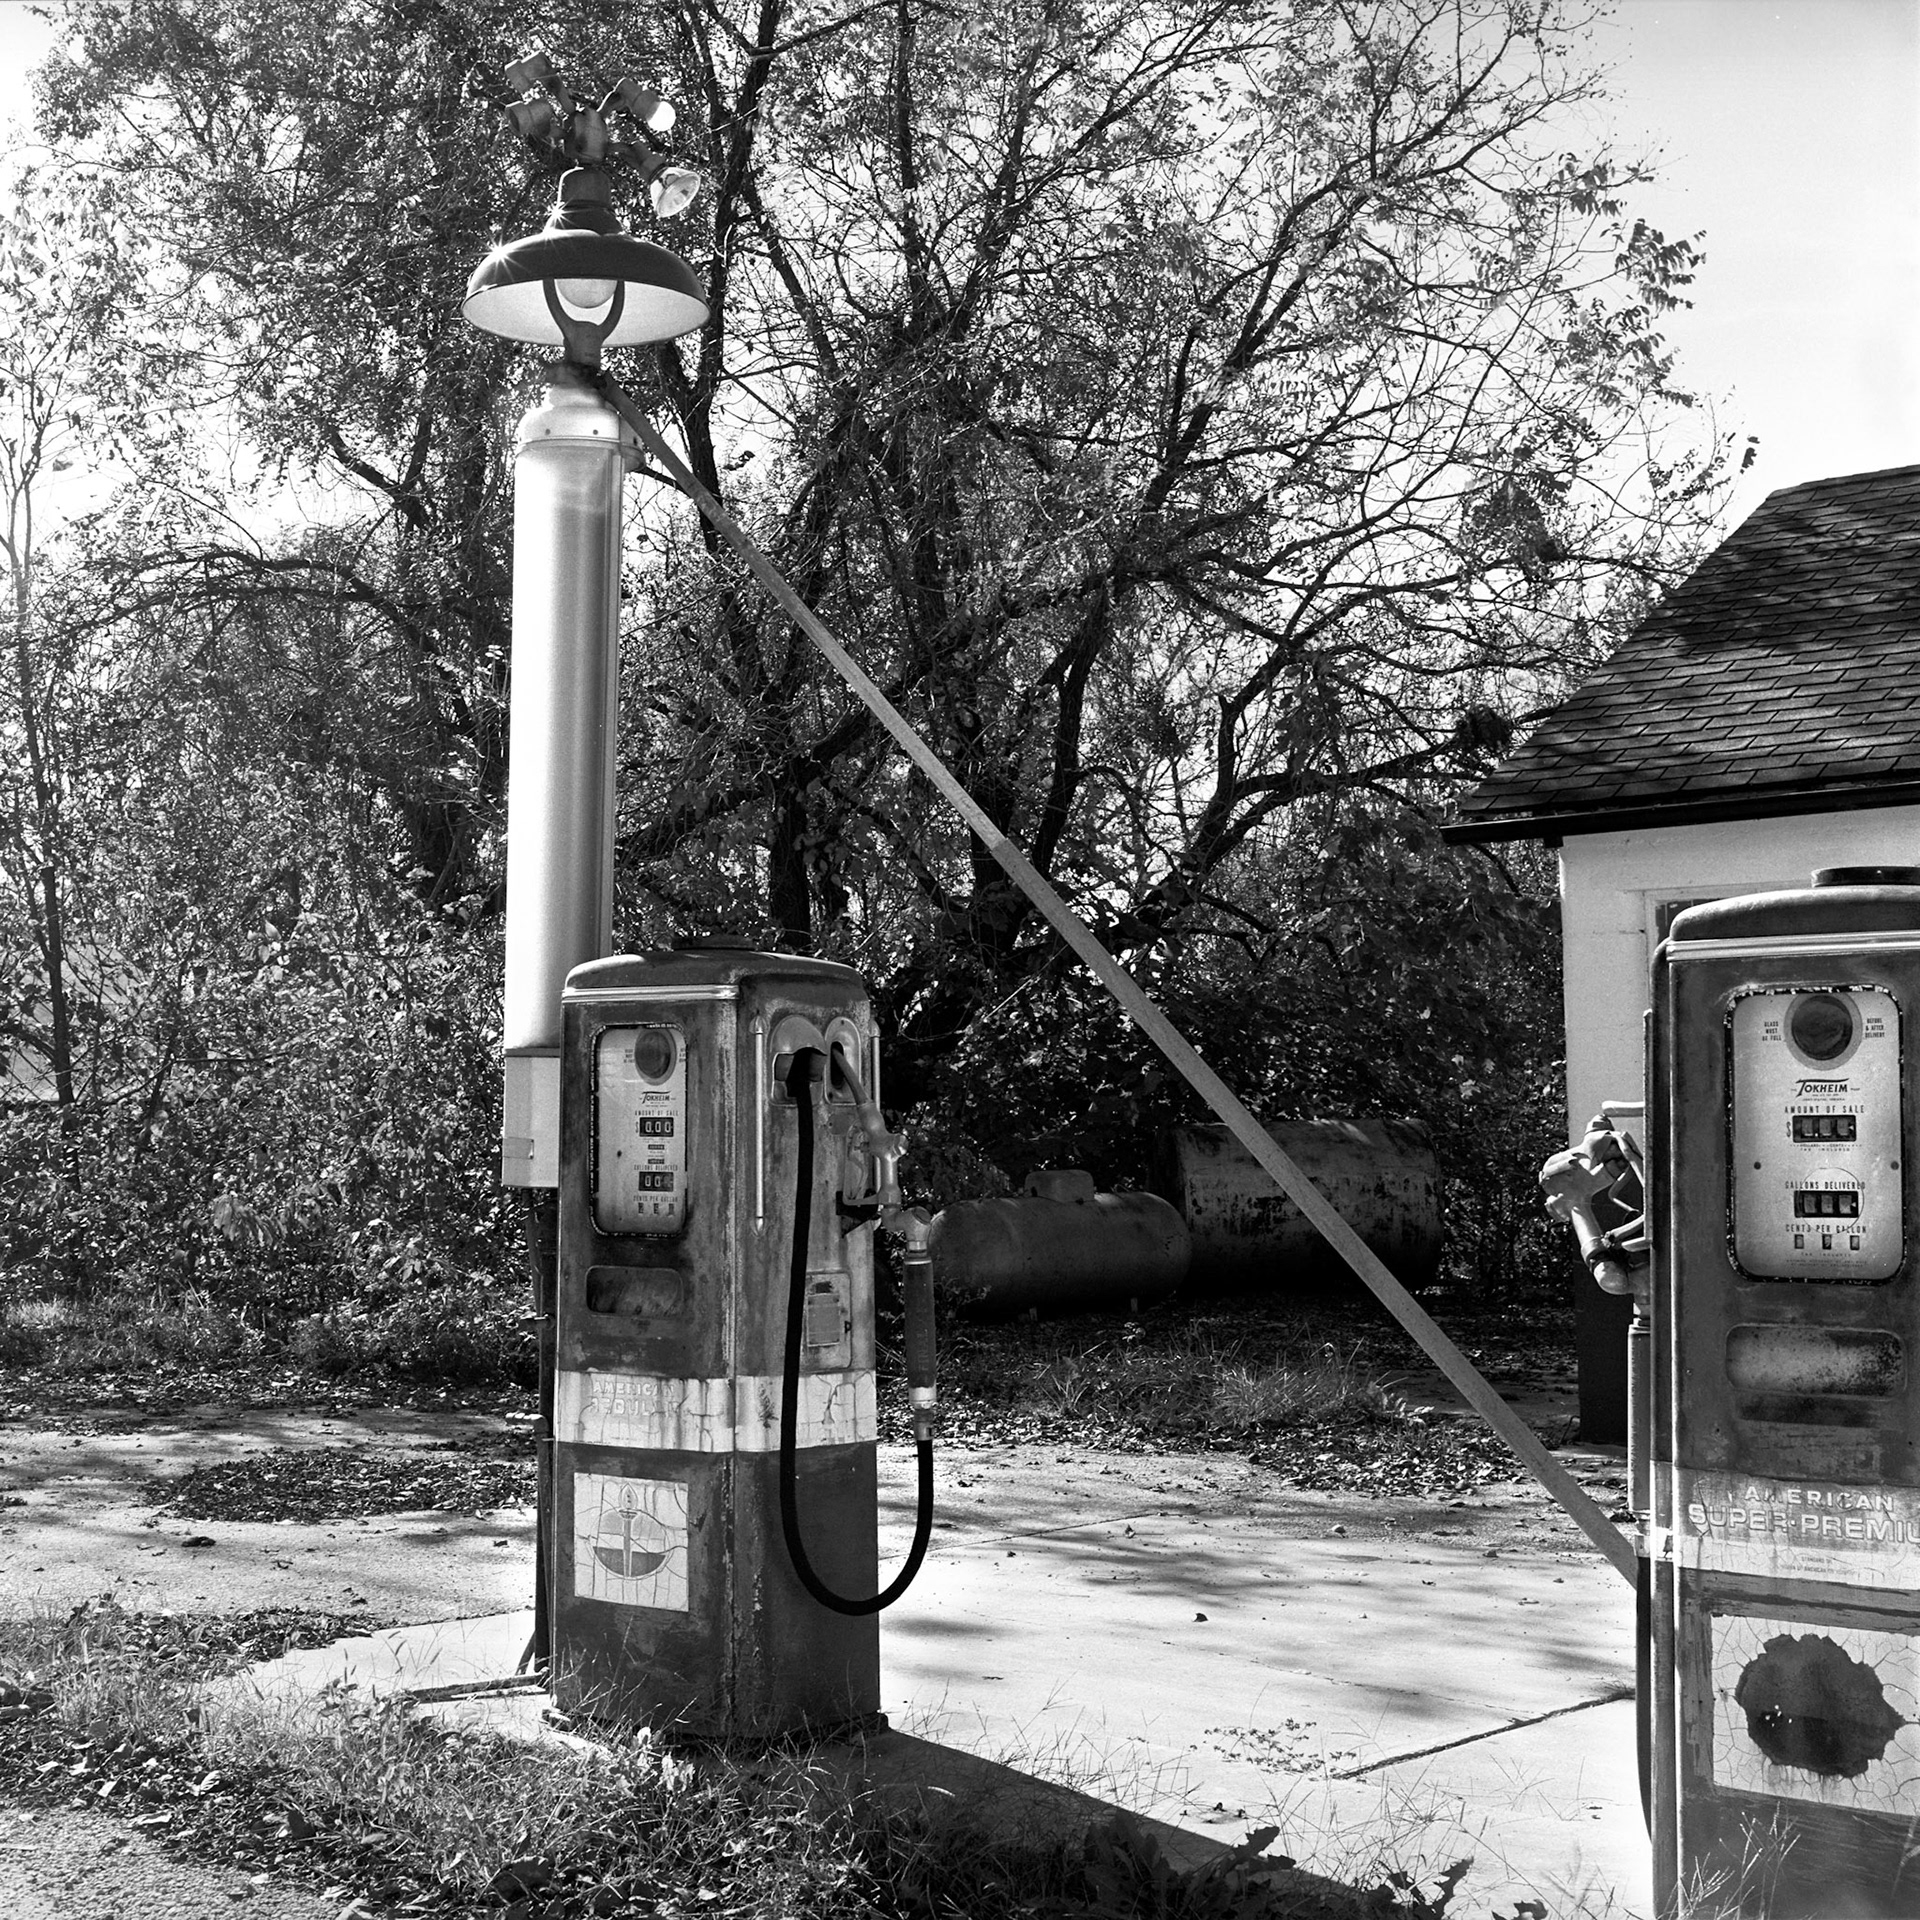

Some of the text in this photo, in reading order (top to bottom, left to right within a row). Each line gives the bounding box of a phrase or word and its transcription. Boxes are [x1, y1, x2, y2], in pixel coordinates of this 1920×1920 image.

[1795, 1078, 1850, 1098] TOKHEIM
[1784, 1105, 1864, 1114] AMOUNT OF SALE
[1785, 1181, 1820, 1190] GALLONS
[1816, 1224, 1831, 1233] PER
[1836, 1225, 1867, 1234] GALLON
